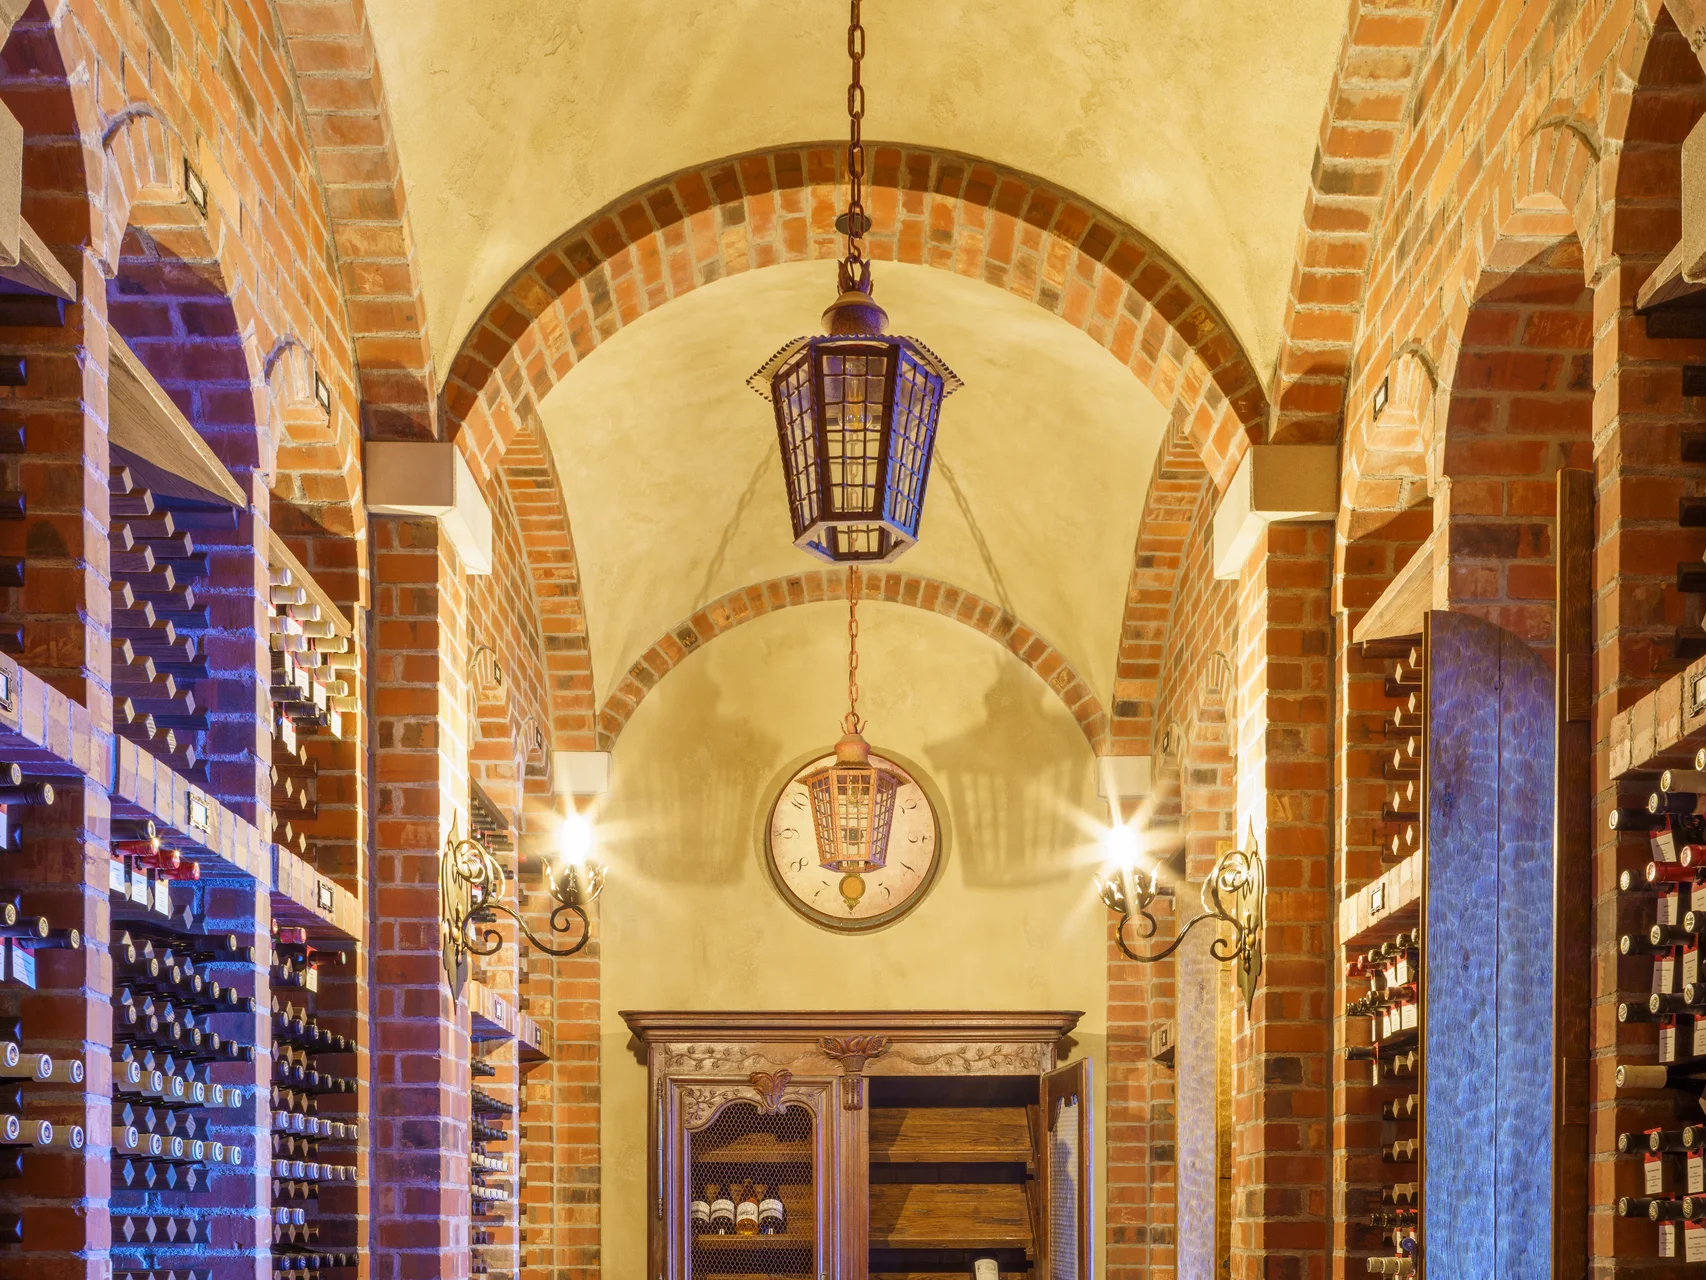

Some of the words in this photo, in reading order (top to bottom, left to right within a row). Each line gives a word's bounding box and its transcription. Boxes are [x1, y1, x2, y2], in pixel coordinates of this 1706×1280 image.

[791, 792, 809, 811] 10
[775, 827, 800, 840] 9
[790, 856, 809, 873] 8
